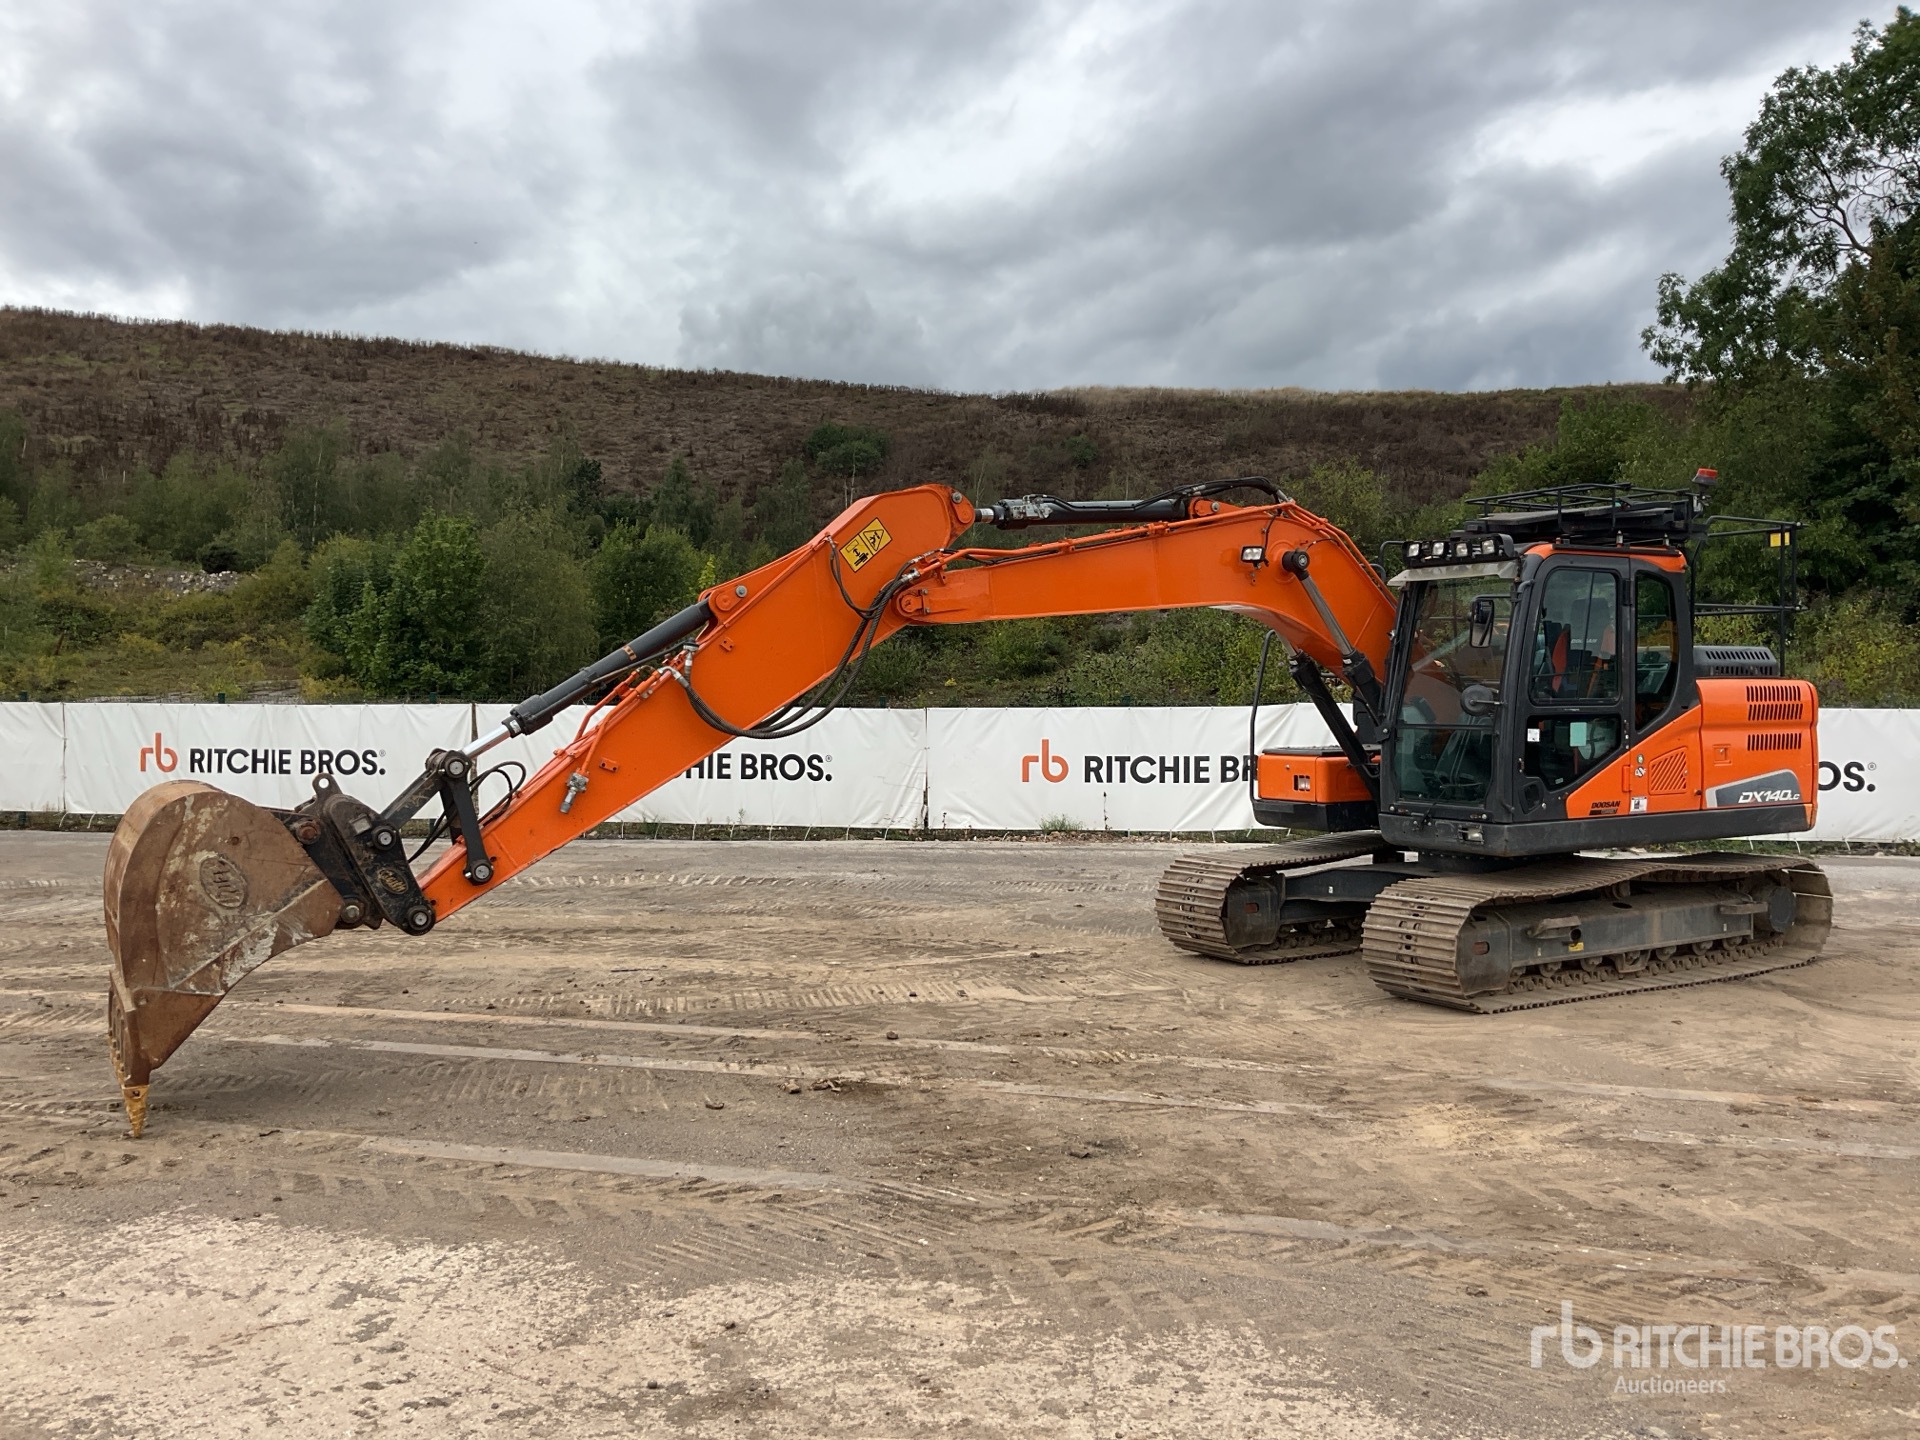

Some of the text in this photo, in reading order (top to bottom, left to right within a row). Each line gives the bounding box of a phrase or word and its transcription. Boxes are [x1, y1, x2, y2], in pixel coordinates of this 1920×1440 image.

[189, 748, 291, 775] RITCHIE
[674, 753, 731, 780] HIE
[1084, 755, 1211, 784] RITCHIE
[1591, 800, 1621, 809] DOOSAN
